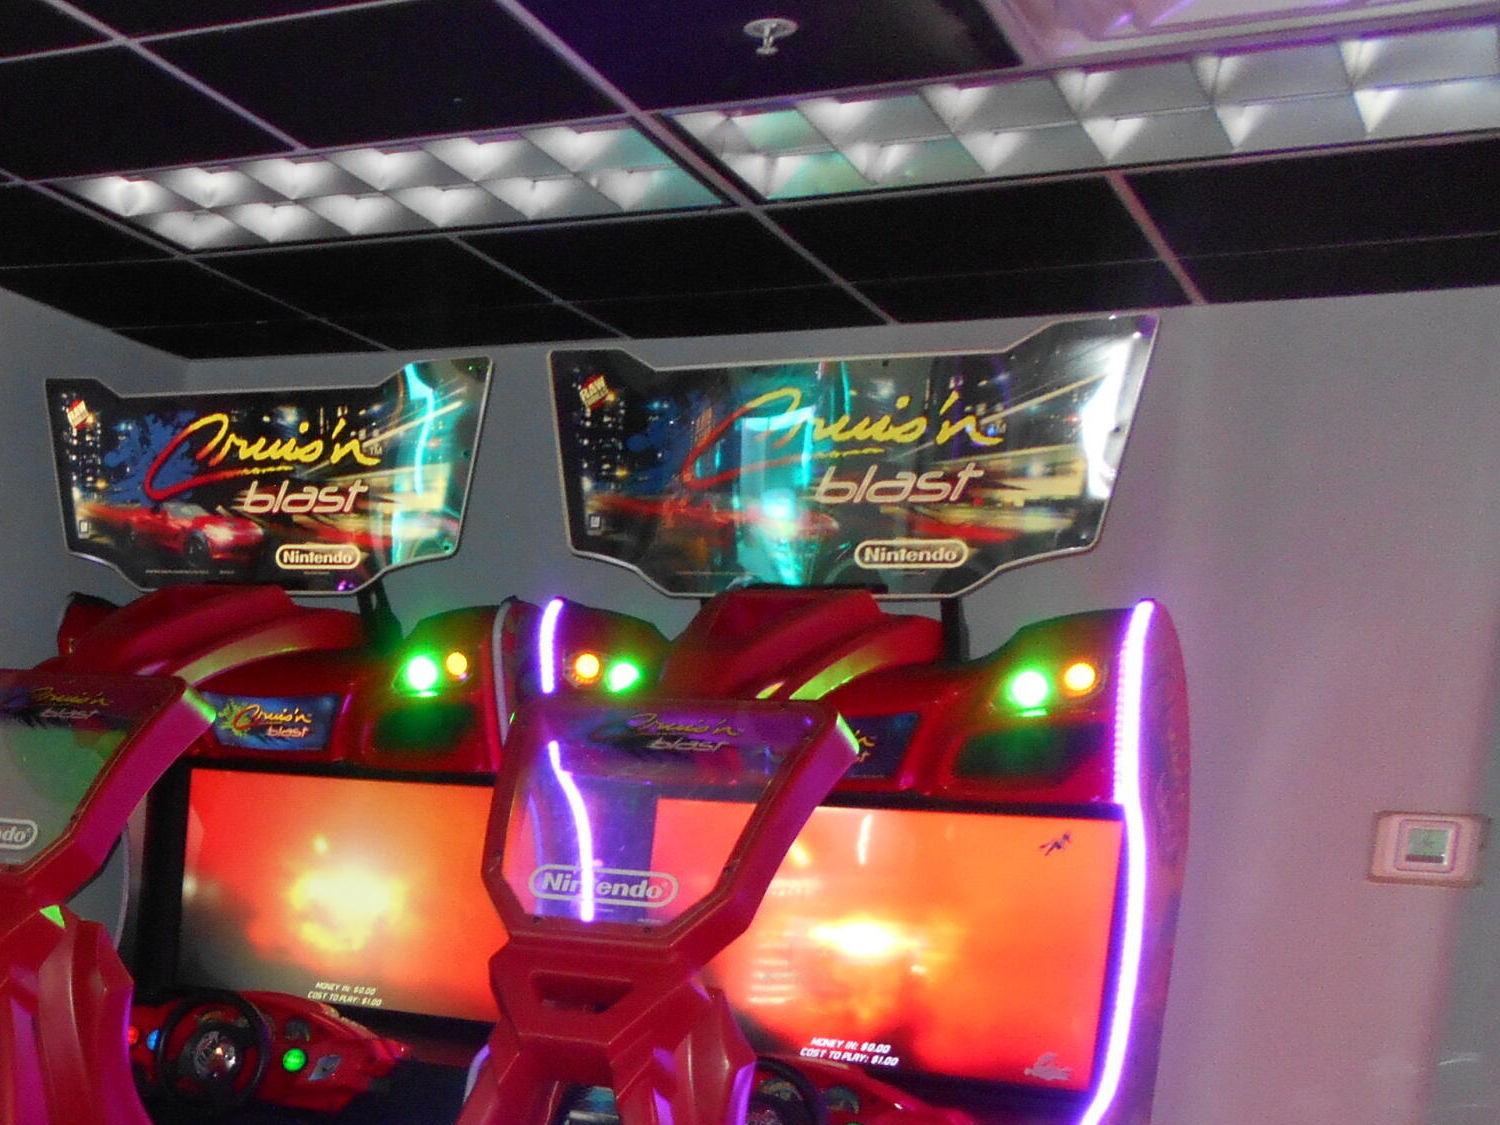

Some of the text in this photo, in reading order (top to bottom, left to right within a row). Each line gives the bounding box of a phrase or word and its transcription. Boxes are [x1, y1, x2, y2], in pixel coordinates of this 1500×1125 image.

[681, 387, 1005, 489] Cruis'n
[144, 412, 381, 500] Cruis'n
[815, 462, 984, 504] blast
[242, 479, 369, 515] blast
[282, 550, 353, 565] Nintendo
[863, 545, 957, 564] Nintendo
[232, 703, 312, 730] Cruis'n
[541, 872, 663, 899] Ninendo
[307, 990, 328, 1001] COST
[329, 993, 339, 1001] TO
[800, 1047, 900, 1067] COST TO PLAY: $1.00
[810, 1037, 892, 1054] MONEY IN: $0.00
